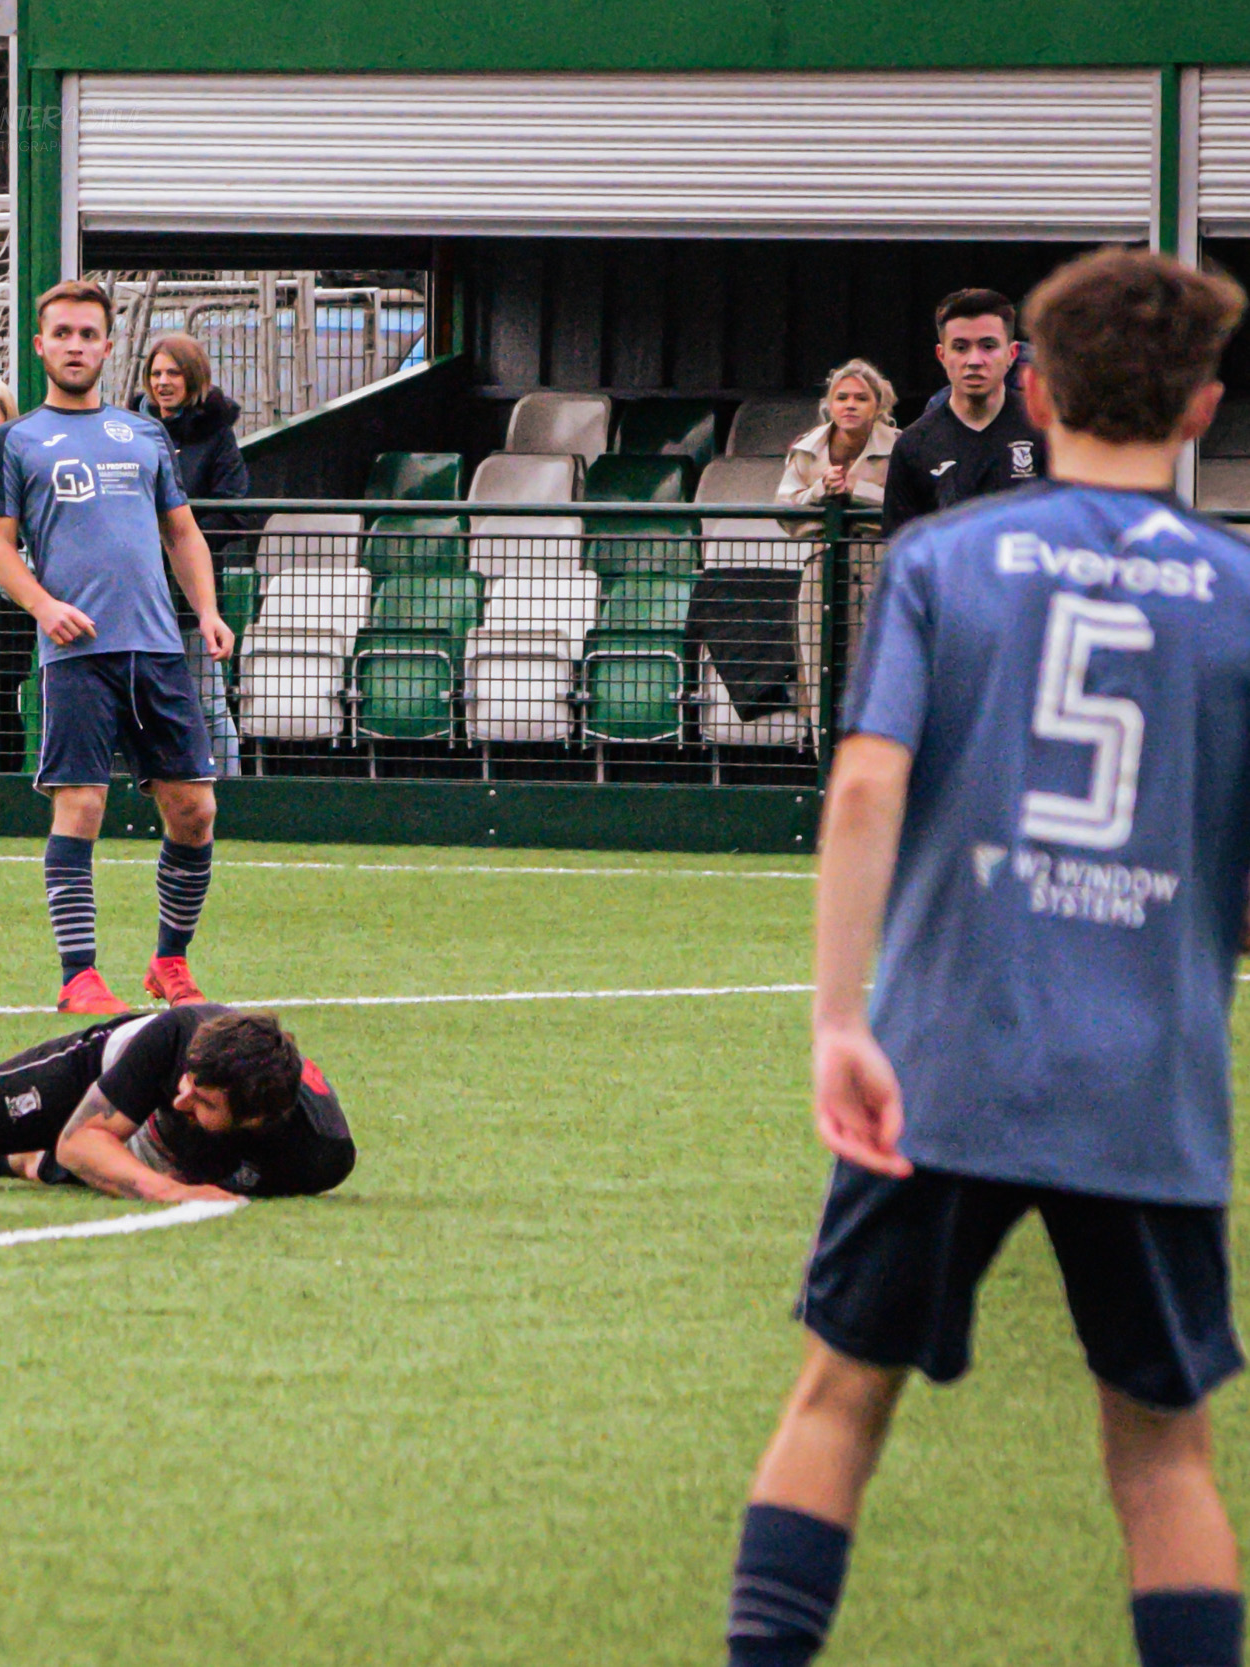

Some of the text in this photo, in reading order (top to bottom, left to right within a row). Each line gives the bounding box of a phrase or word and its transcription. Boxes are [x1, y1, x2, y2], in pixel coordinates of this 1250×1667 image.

[106, 462, 140, 470] PROPERTY
[996, 531, 1217, 602] Everest
[1021, 591, 1155, 850] 5
[1031, 870, 1146, 930] SYSTEMS
[1055, 857, 1180, 902] WINDOW
